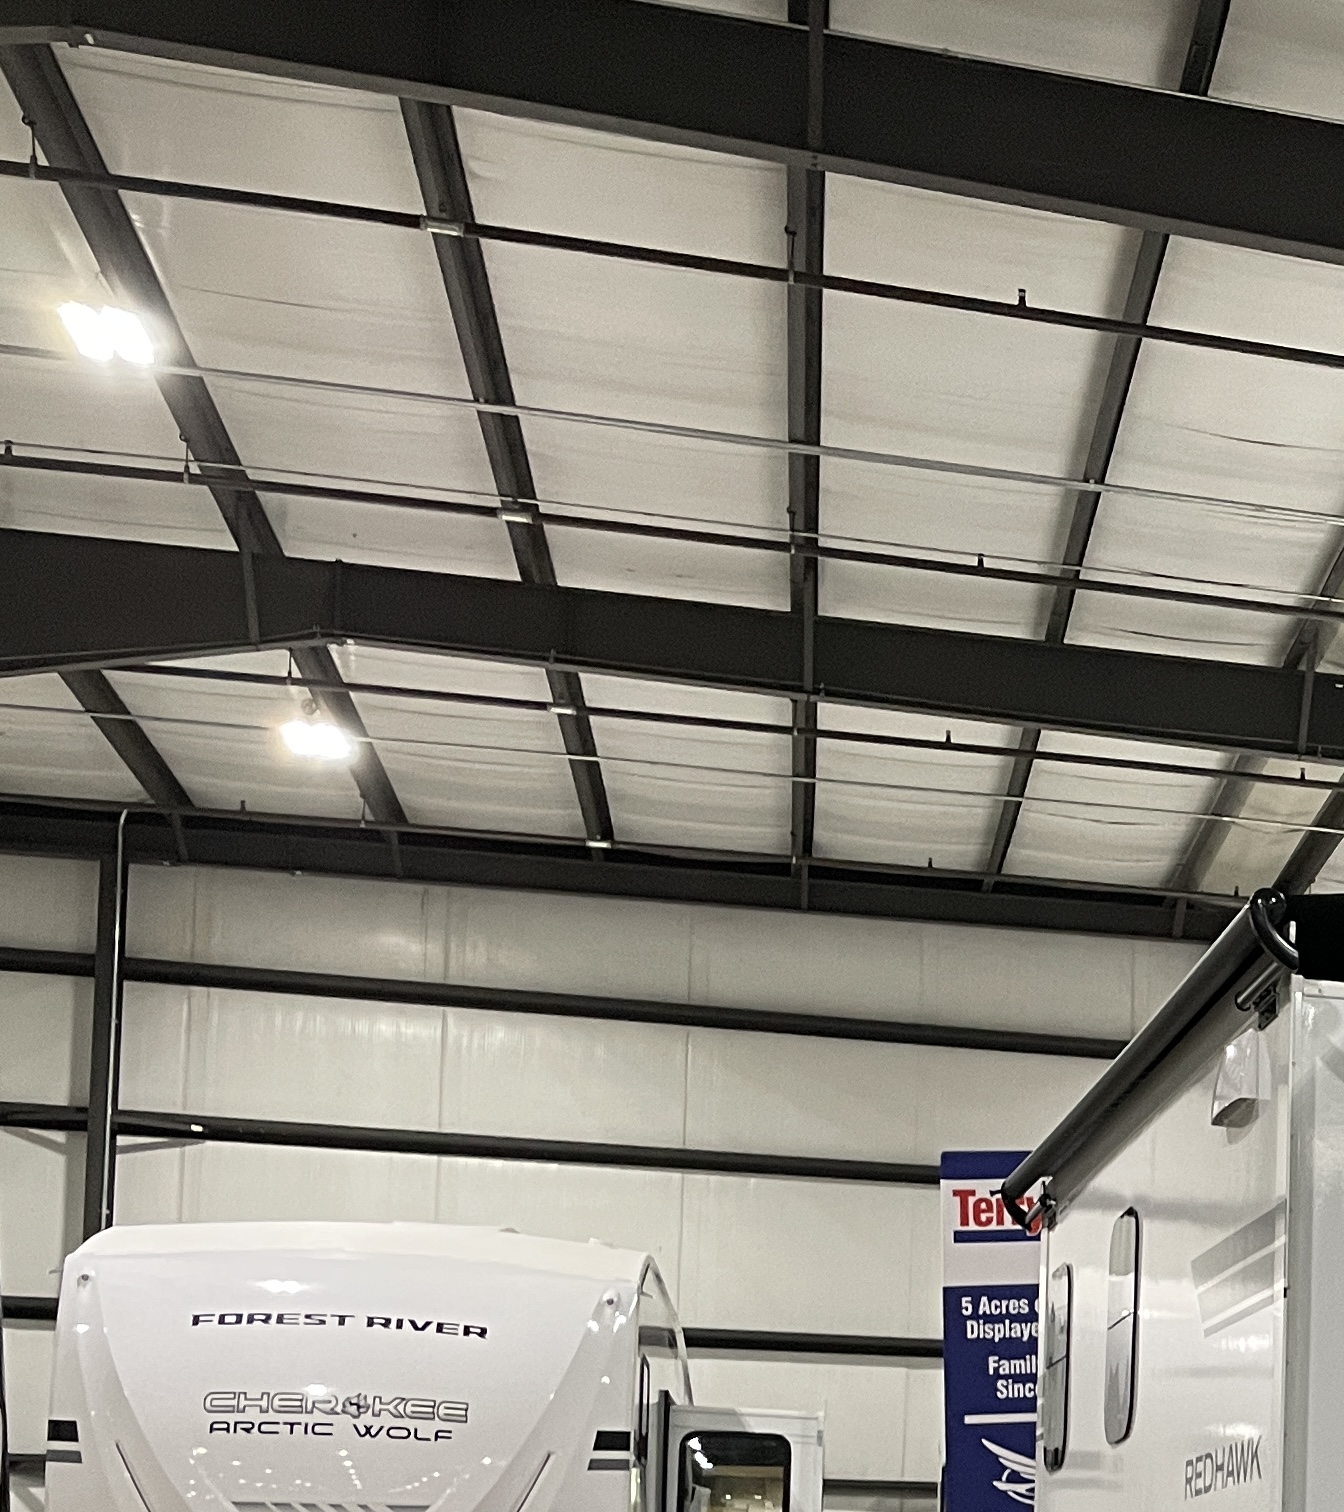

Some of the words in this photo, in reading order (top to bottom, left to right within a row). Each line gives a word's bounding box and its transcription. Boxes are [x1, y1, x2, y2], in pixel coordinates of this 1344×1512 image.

[961, 1297, 973, 1316] 5
[978, 1295, 1030, 1315] Acres
[191, 1312, 355, 1327] FOREST
[366, 1315, 488, 1340] RIVER
[996, 1378, 1038, 1399] Sinc
[208, 1420, 334, 1437] ARCTIC
[352, 1423, 453, 1442] WOLF
[1184, 1434, 1262, 1501] REDHAWK
